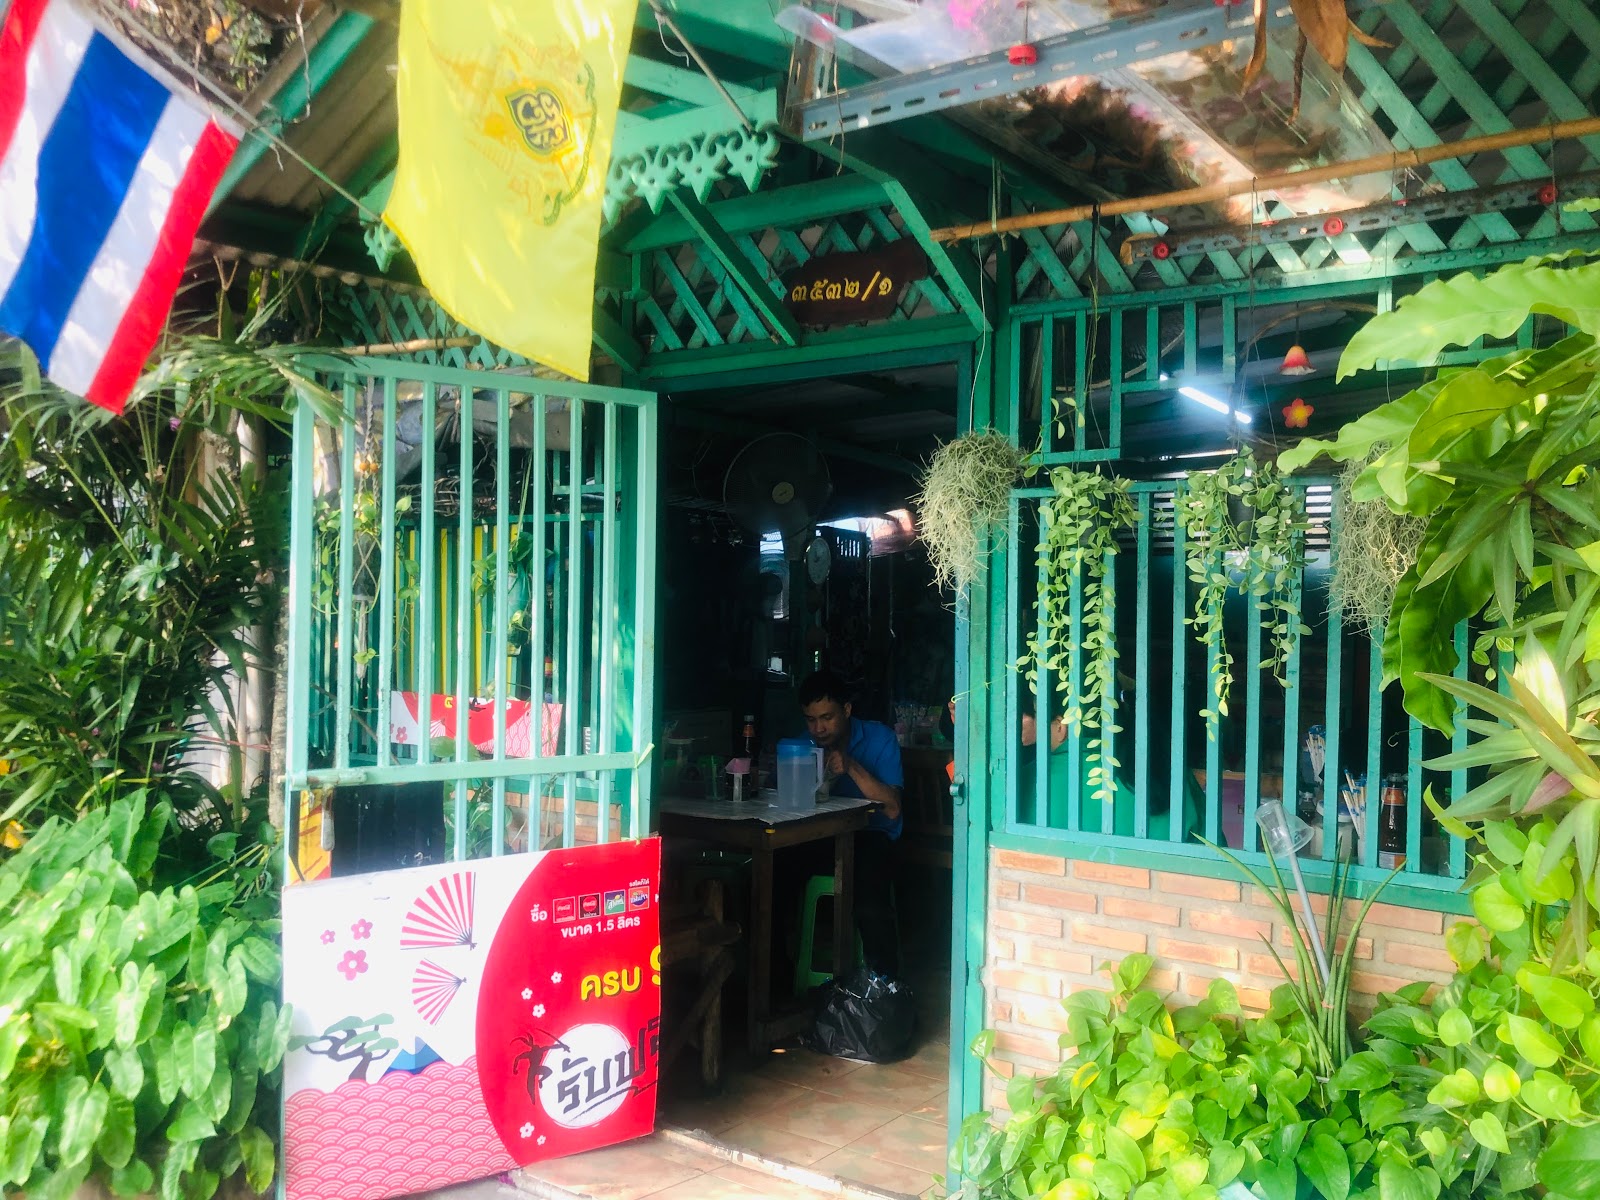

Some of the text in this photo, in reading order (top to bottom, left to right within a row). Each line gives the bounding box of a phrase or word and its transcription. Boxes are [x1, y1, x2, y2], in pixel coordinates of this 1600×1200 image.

[561, 915, 641, 938] ขนาด 1.5 ลิตร
[581, 966, 642, 1001] ครบ
